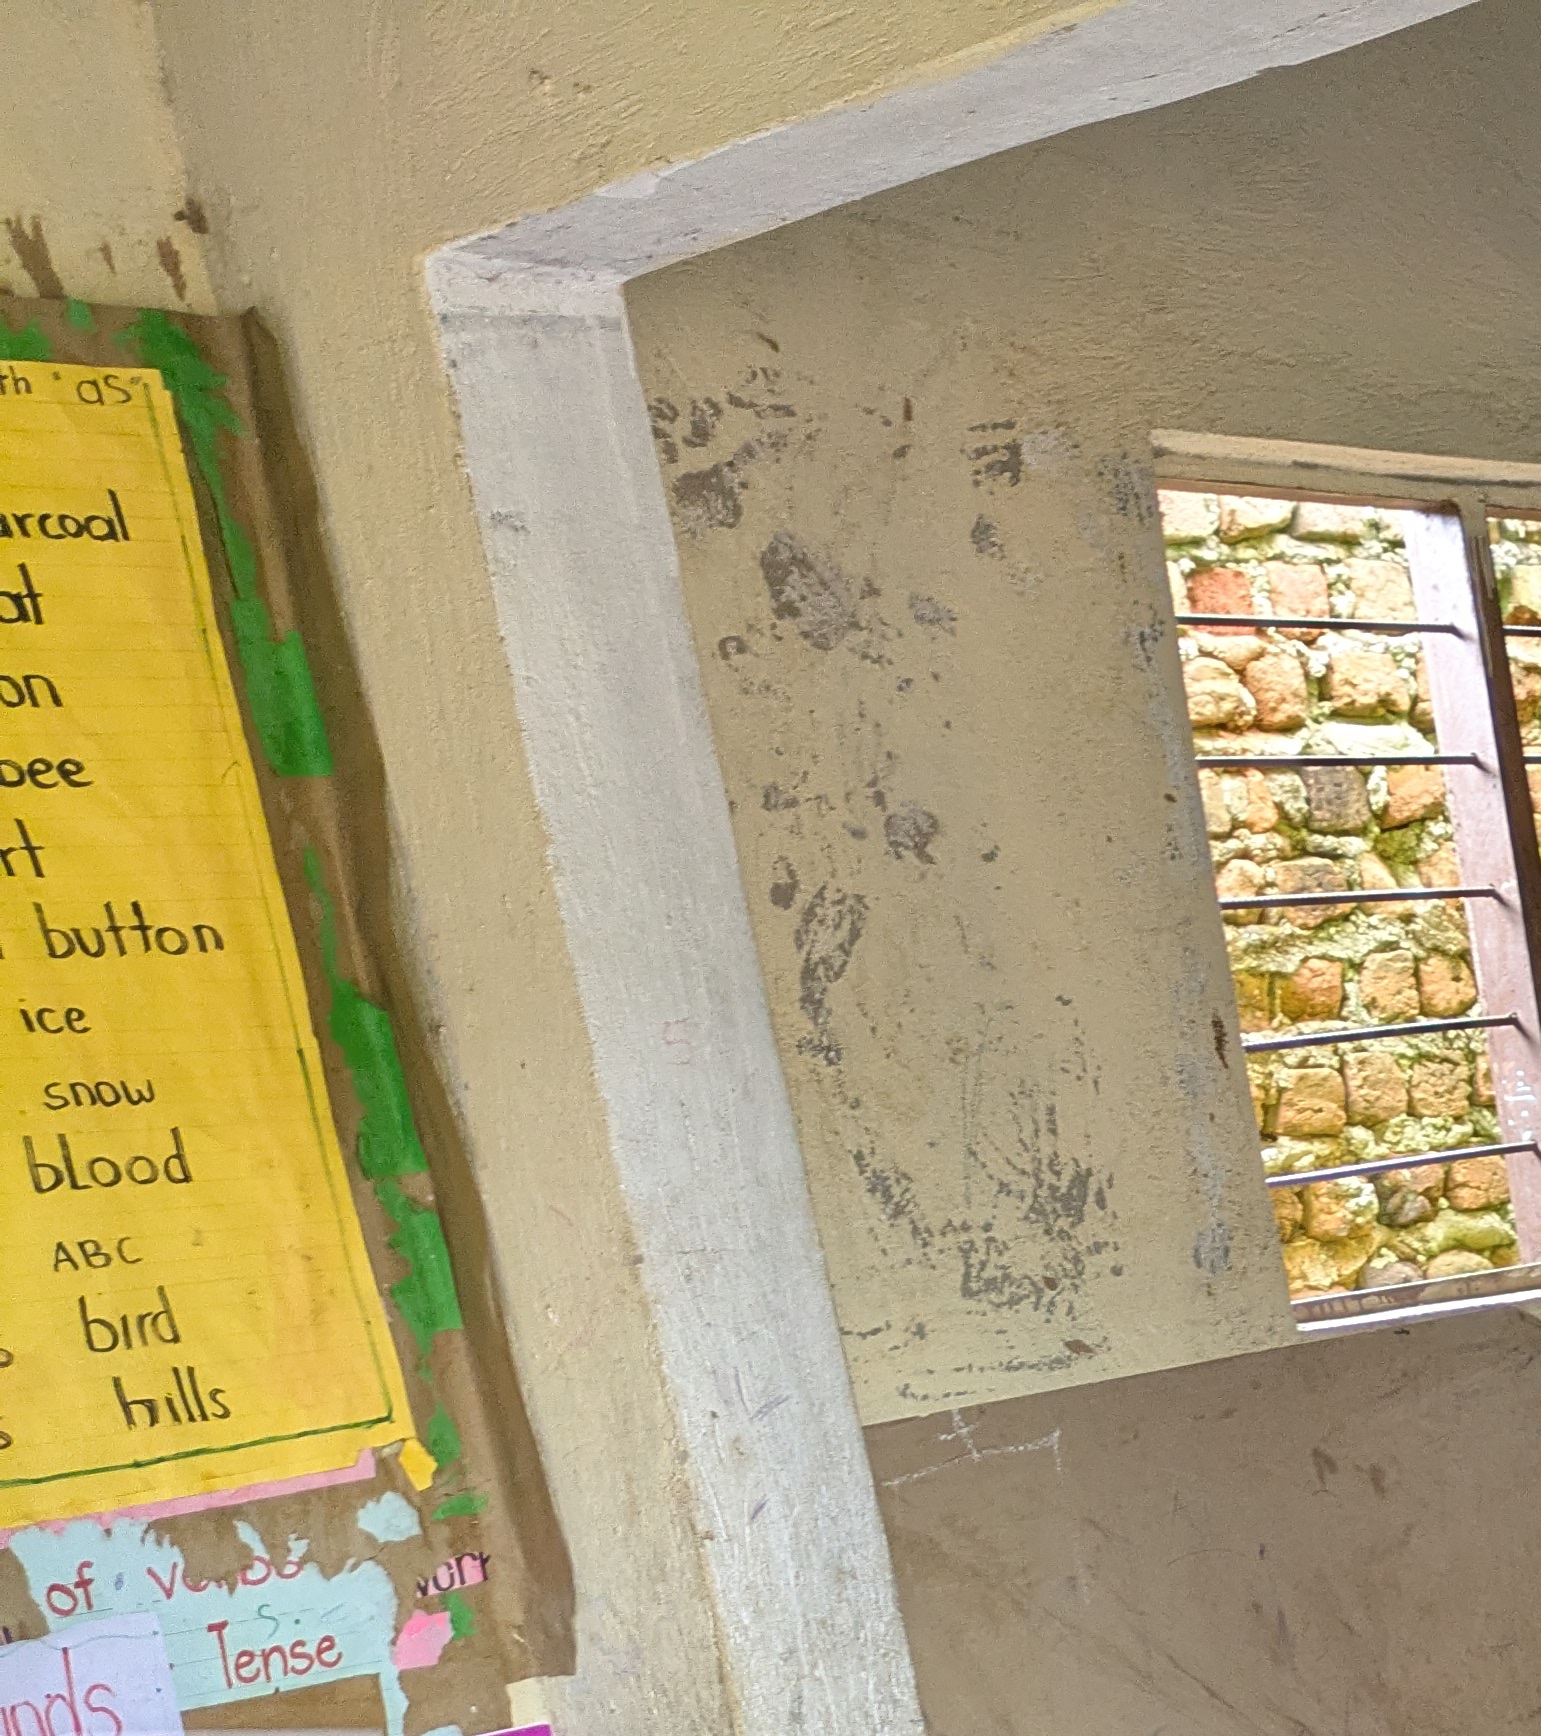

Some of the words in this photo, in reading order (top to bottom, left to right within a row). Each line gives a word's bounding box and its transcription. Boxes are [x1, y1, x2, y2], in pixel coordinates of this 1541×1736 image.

[32, 899, 225, 960] button
[18, 997, 92, 1034] ice
[43, 1078, 156, 1111] snow
[22, 1126, 194, 1194] blood
[53, 1236, 144, 1272] ABC
[78, 1284, 182, 1354] bird
[111, 1365, 232, 1431] hills
[46, 1560, 96, 1618] of
[207, 1619, 343, 1690] Tense
